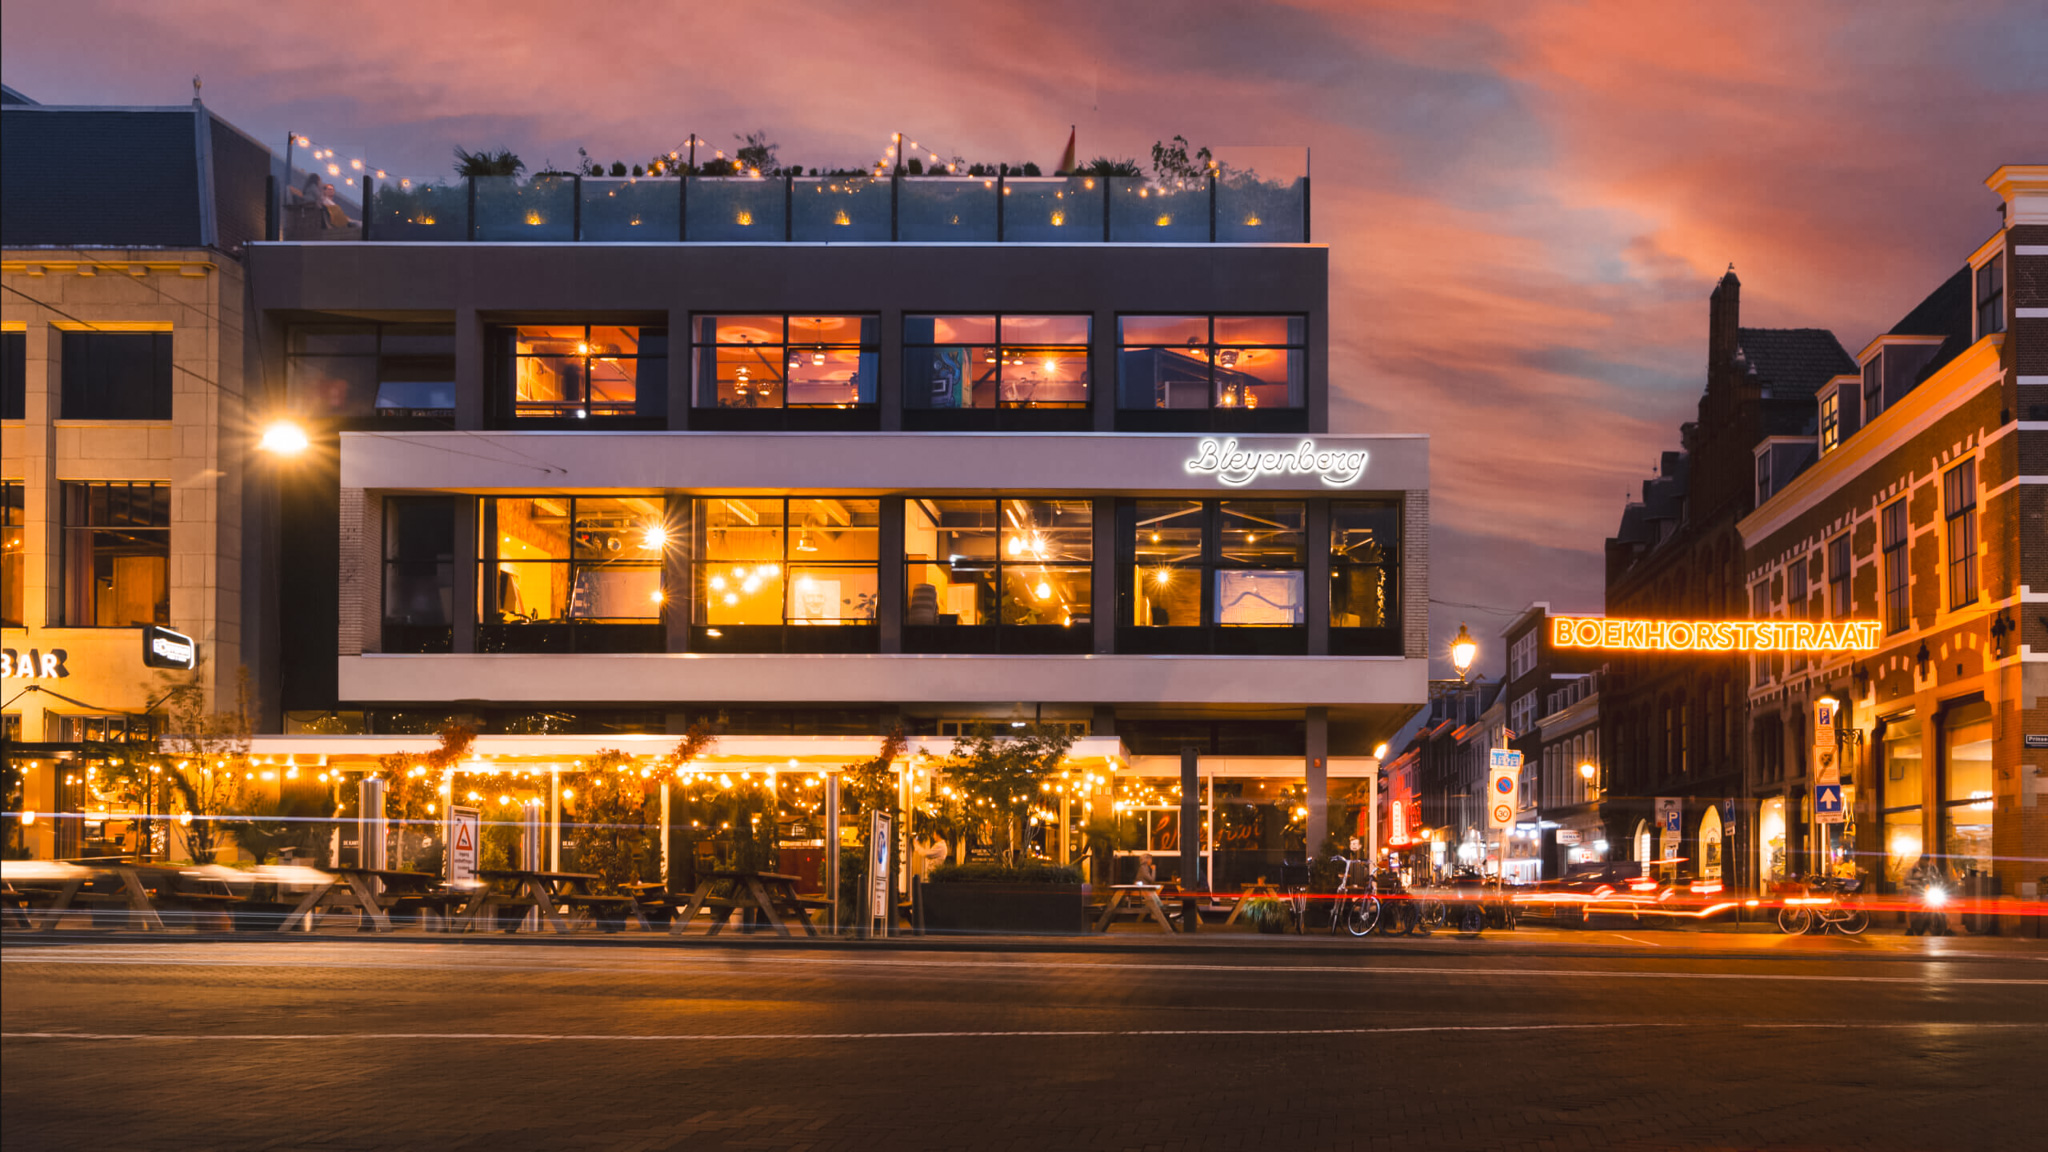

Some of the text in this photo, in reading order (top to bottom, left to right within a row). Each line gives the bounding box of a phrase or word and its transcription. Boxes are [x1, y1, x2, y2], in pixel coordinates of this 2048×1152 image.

[1186, 439, 1368, 486] Bleyenberg
[1553, 618, 1881, 650] BOEKHORSTSTRAAT
[1498, 810, 1508, 818] 30
